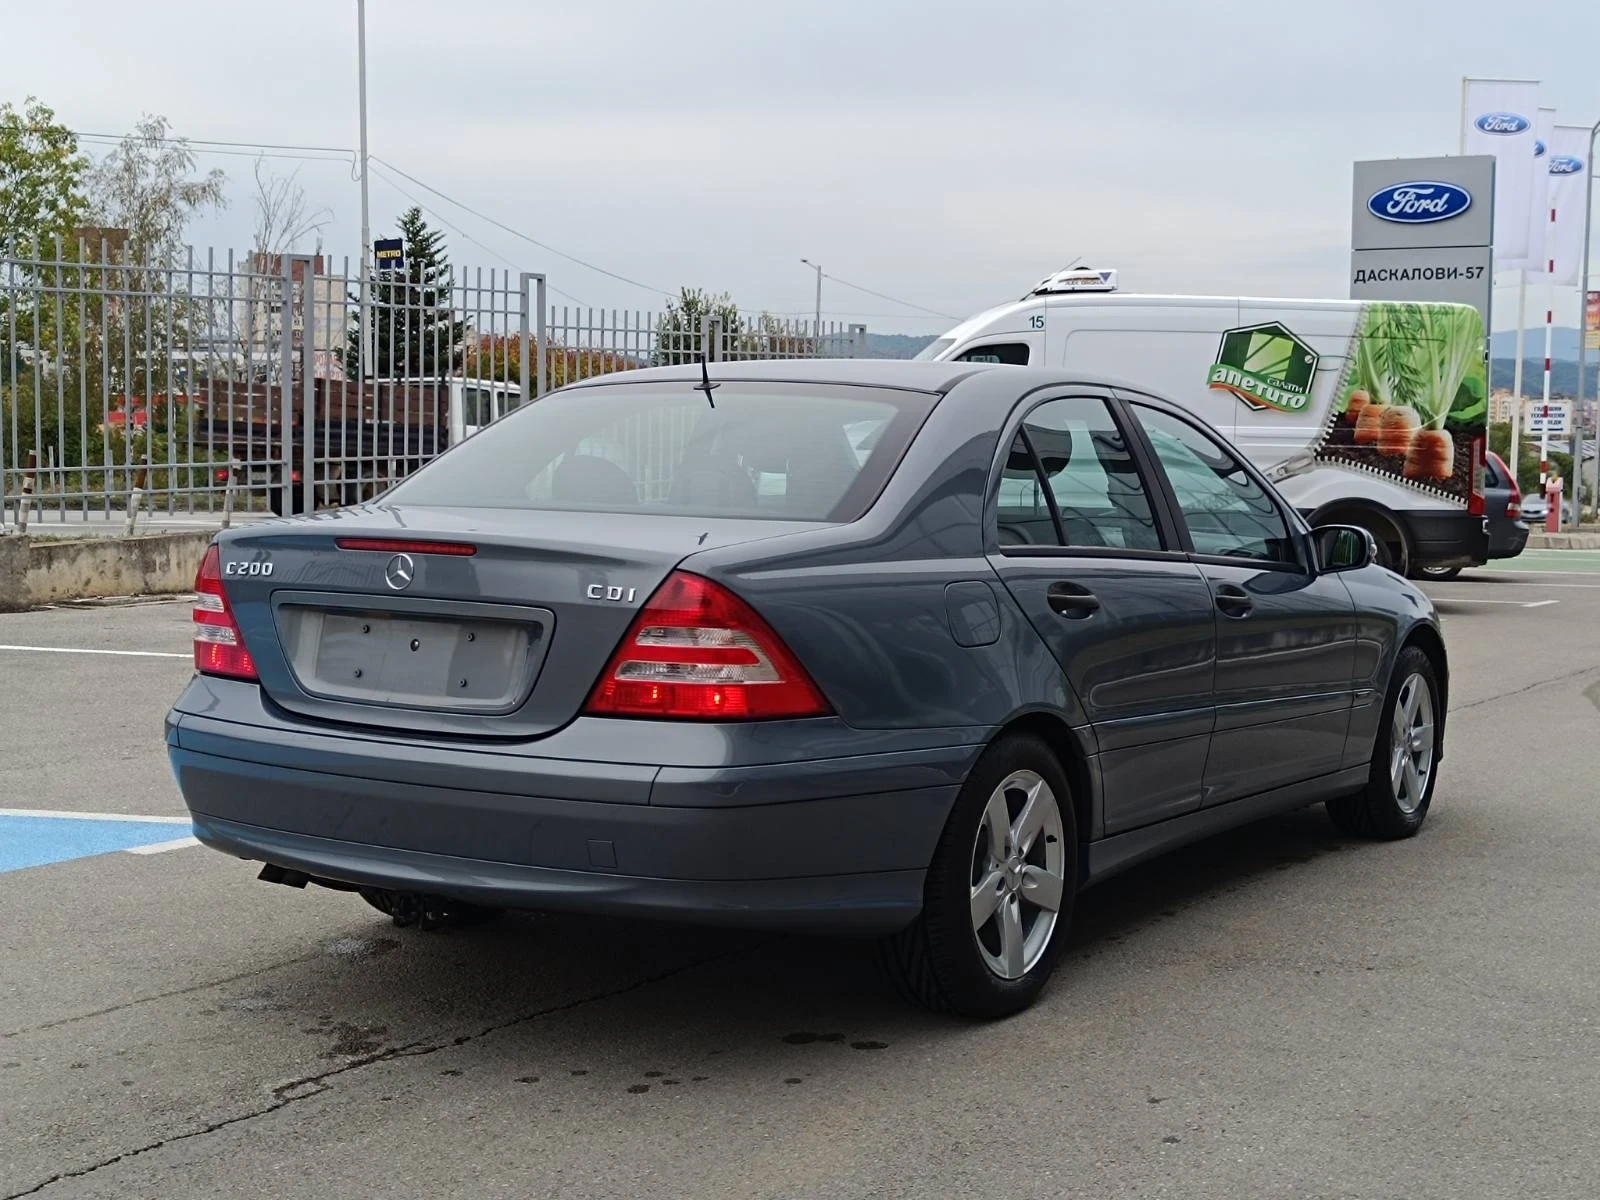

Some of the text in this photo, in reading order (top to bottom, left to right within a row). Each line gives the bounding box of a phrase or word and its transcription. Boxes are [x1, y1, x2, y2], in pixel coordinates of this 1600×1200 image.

[1484, 115, 1519, 131] Ford
[1386, 187, 1450, 214] Ford
[376, 250, 401, 258] METRO
[1353, 266, 1485, 284] ДАСКАЛОВИ-57
[1028, 315, 1045, 329] 15
[587, 584, 636, 602] CDI
